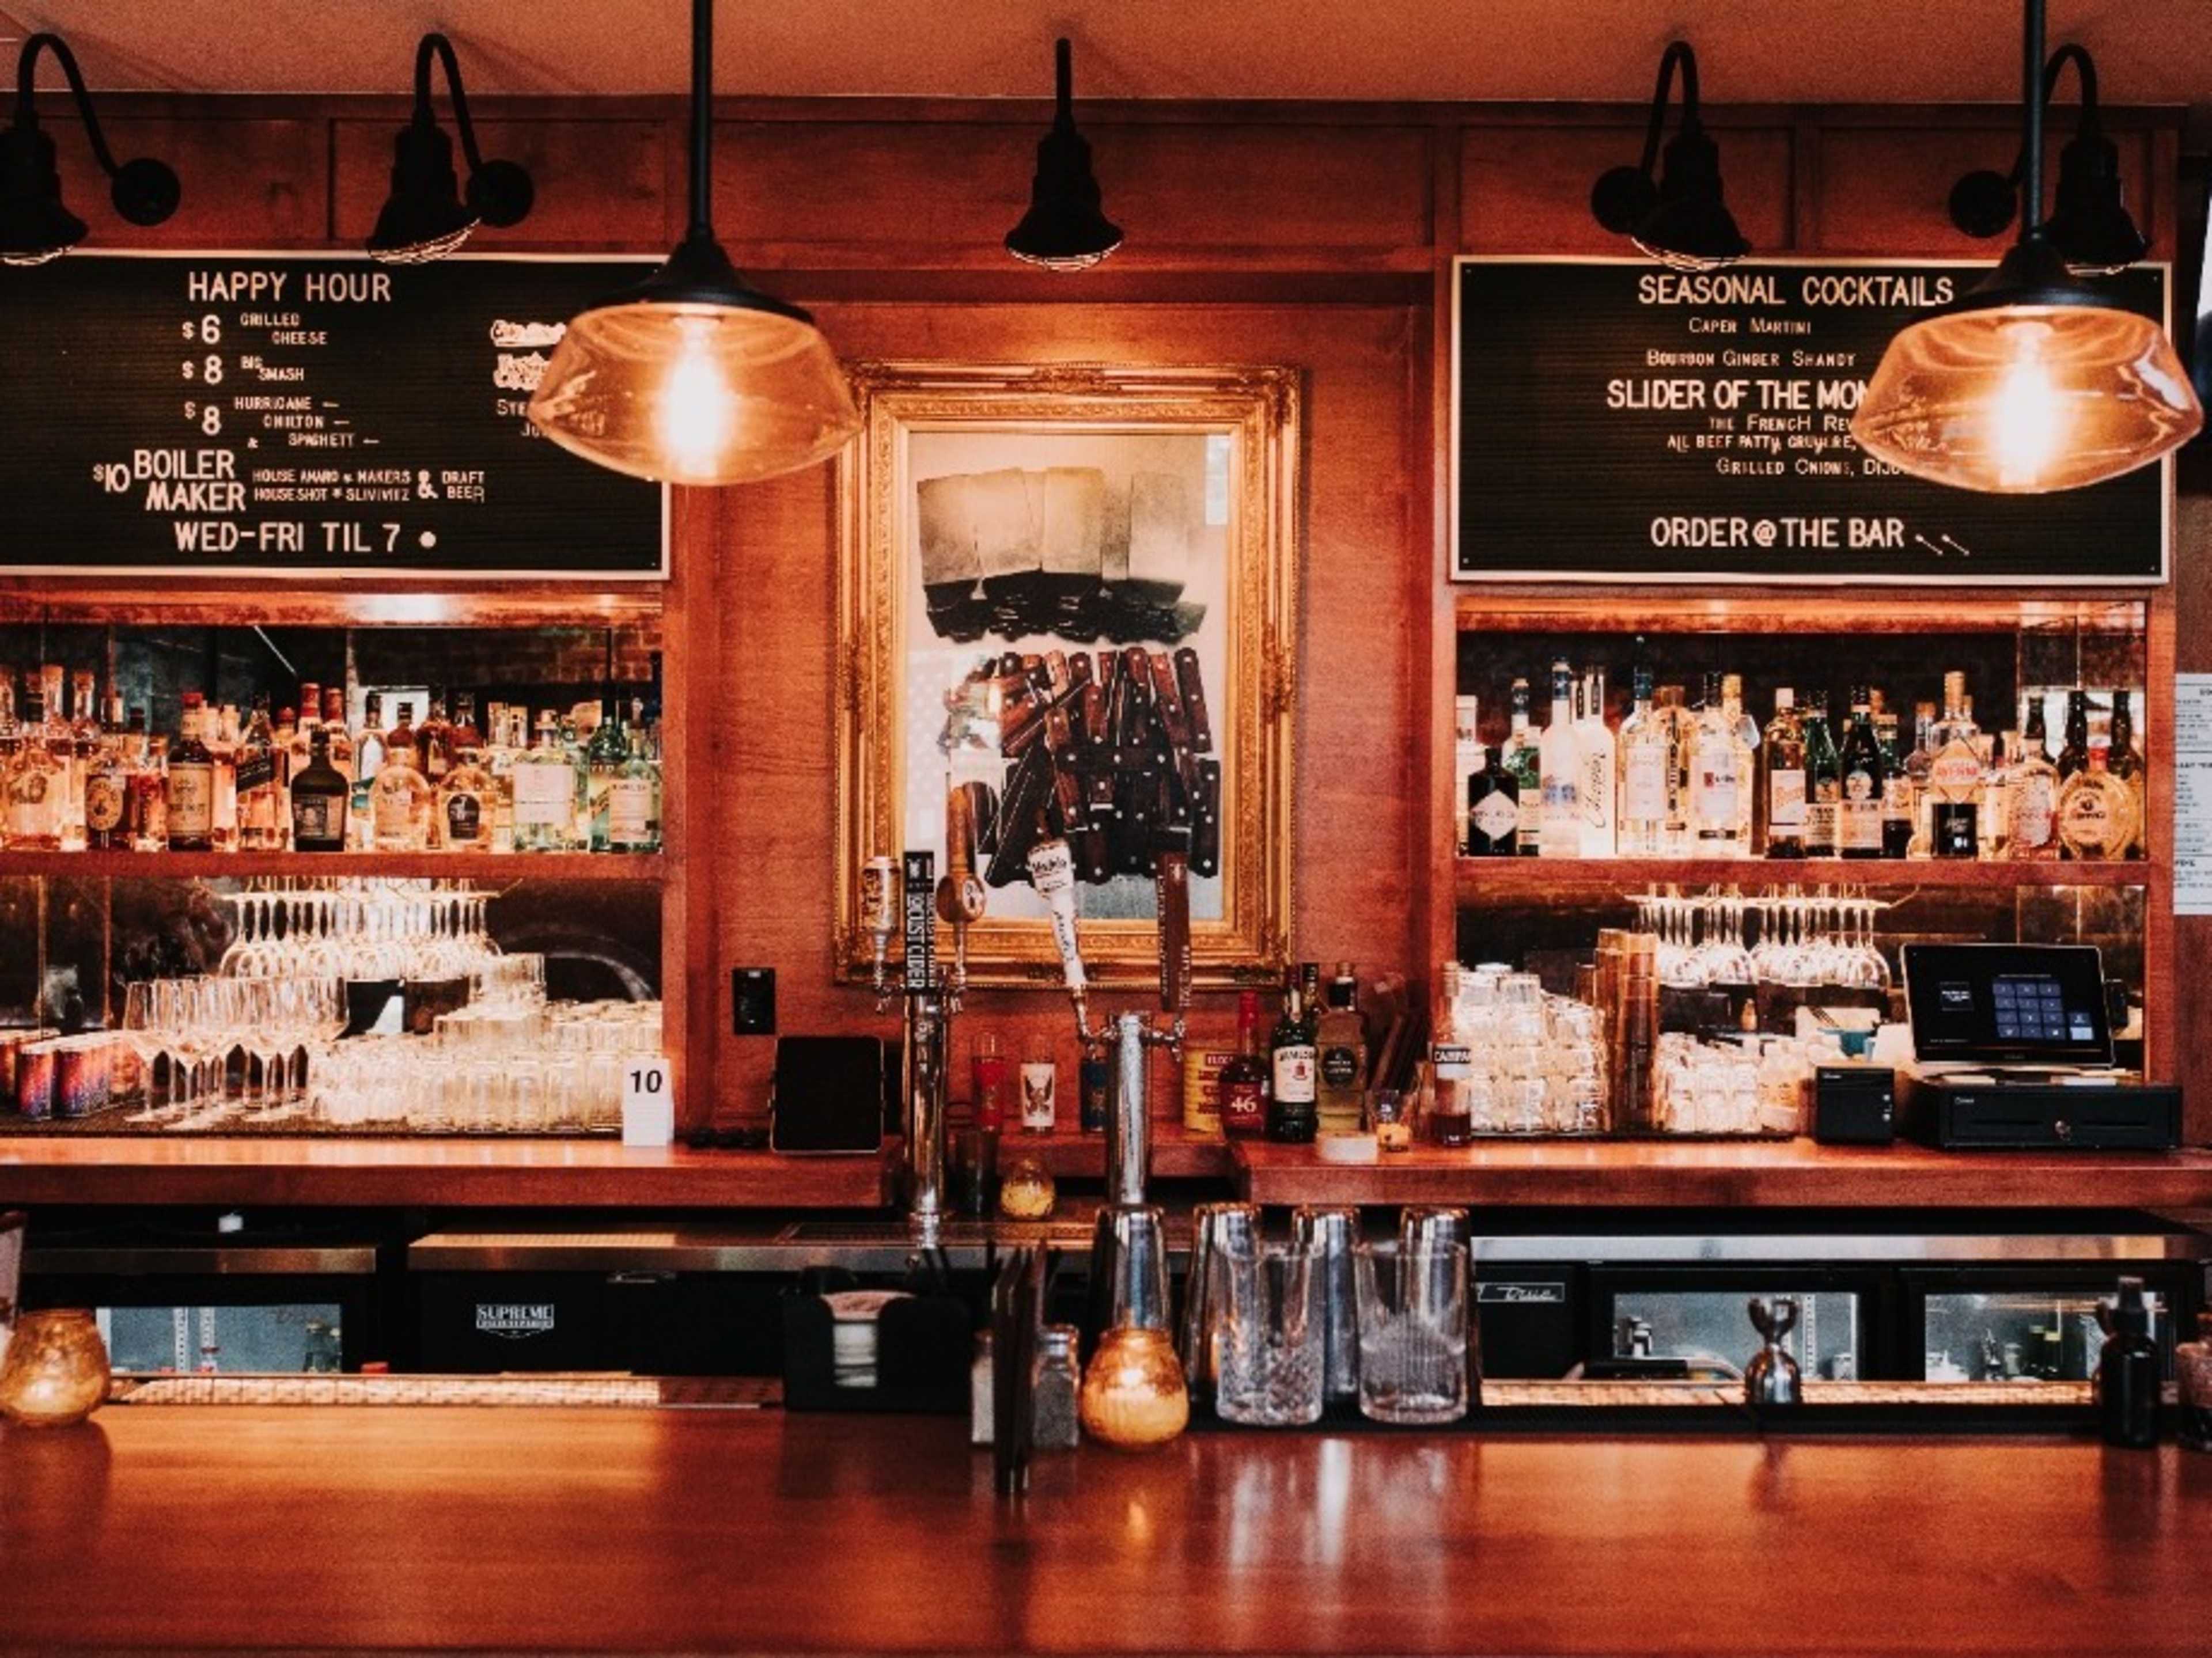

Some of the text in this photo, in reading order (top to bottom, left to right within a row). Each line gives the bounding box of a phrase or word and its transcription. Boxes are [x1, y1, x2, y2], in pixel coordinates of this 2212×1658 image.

[189, 271, 391, 302] HAPPY HOUR
[1638, 274, 1954, 307] SEASONAL COCKTAILS
[240, 313, 300, 327] GRILLED
[271, 331, 327, 345] CHEESE
[257, 366, 304, 381] SMASH
[234, 396, 311, 411] HURRICANE
[1607, 379, 1868, 410] SLIDER OF THE MON
[497, 399, 525, 416] STE
[1823, 413, 1853, 433] REV
[1696, 434, 1733, 449] BEEF
[134, 449, 235, 480] BOILER
[253, 469, 296, 483] HOUSE
[358, 470, 411, 484] MAKERS
[442, 471, 484, 484] DRAFT
[146, 481, 246, 511] MAKER
[446, 485, 484, 502] BEER
[174, 521, 400, 552] WED-FRI TIL 7
[1849, 518, 1904, 548] BAR
[906, 945, 925, 988] CIDER
[631, 1069, 662, 1093] 10
[1230, 1095, 1257, 1113] 46
[478, 1304, 554, 1319] SUPREME
